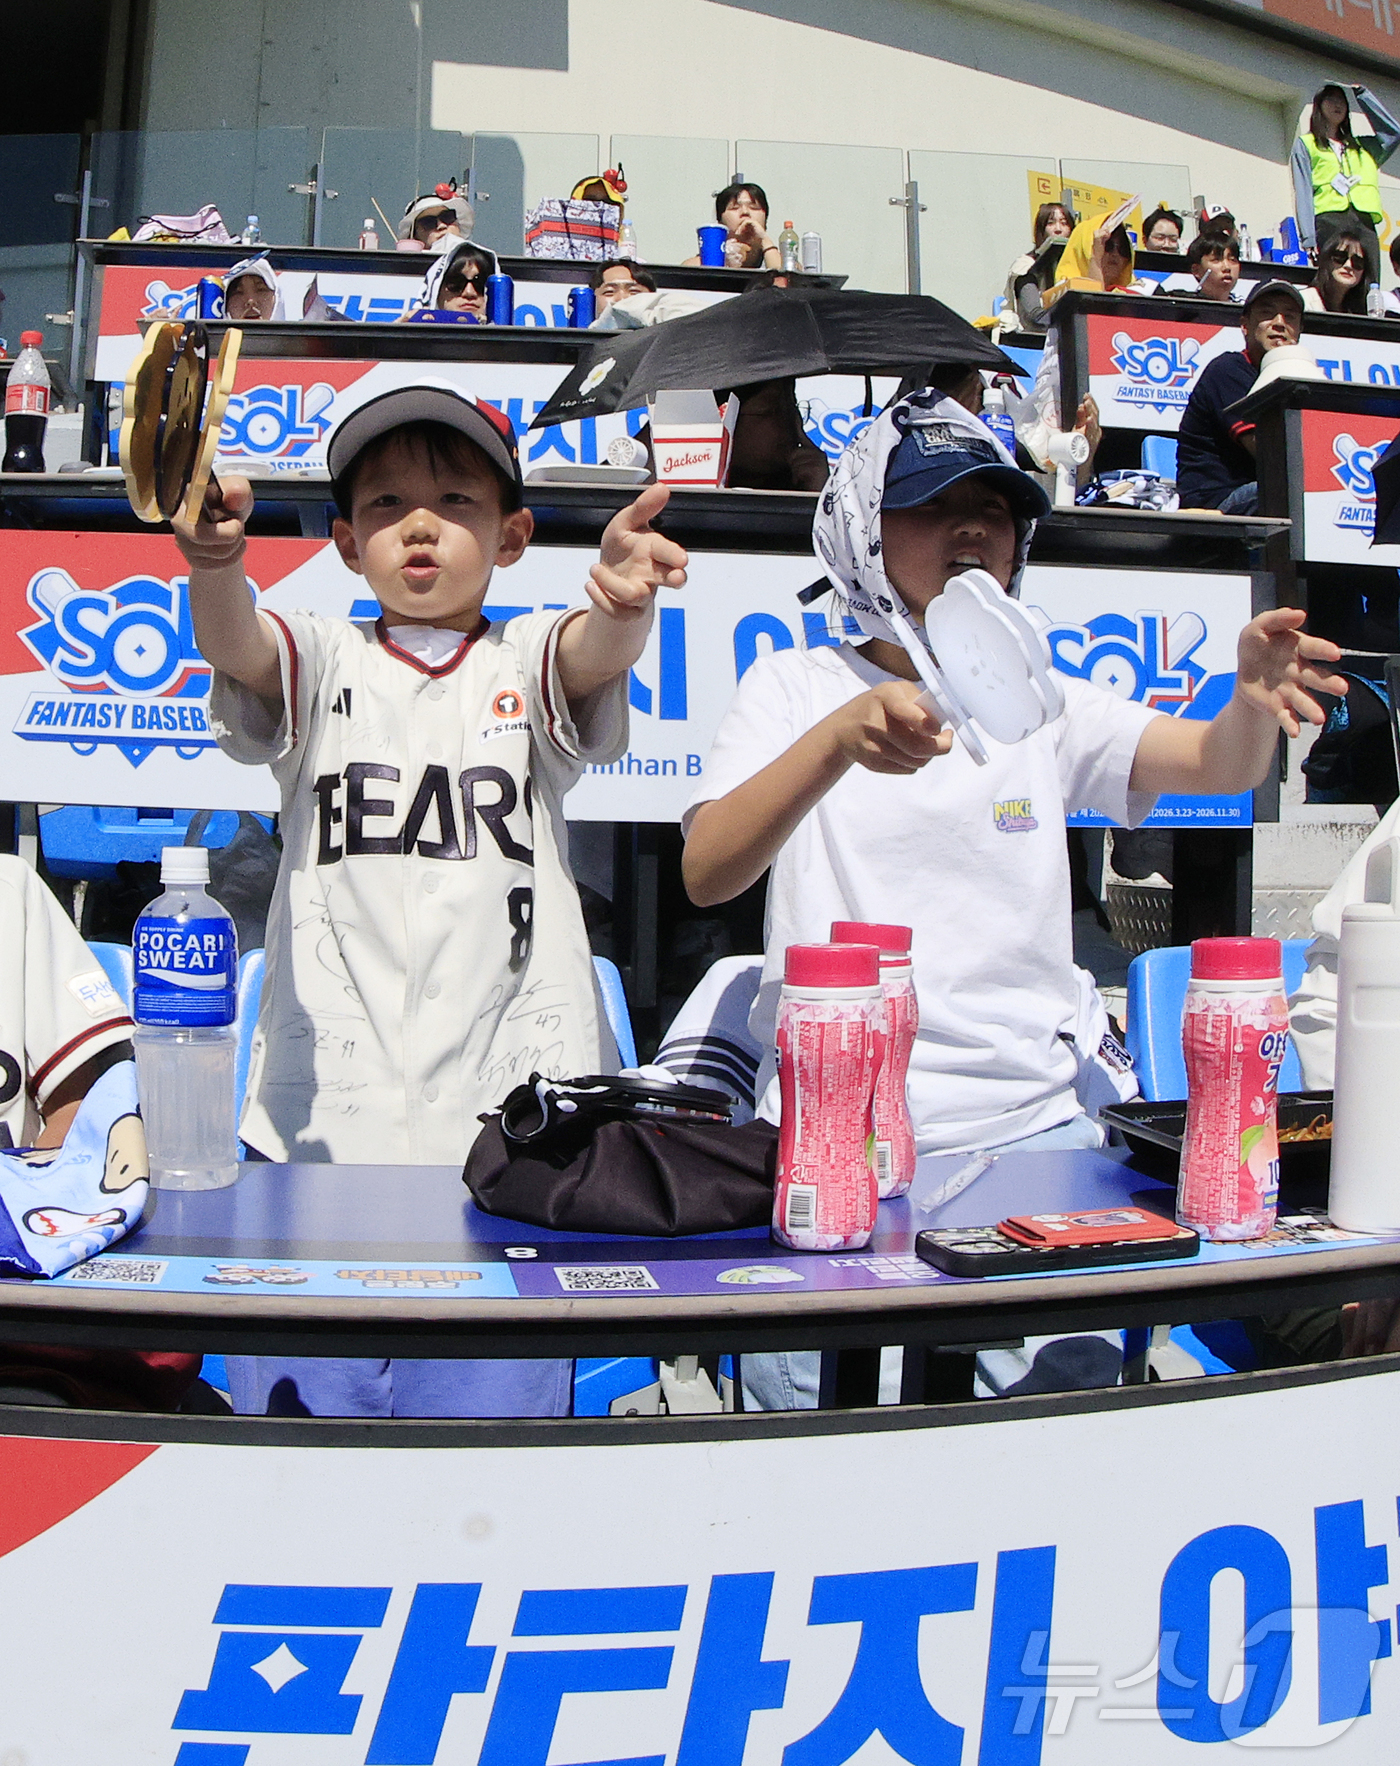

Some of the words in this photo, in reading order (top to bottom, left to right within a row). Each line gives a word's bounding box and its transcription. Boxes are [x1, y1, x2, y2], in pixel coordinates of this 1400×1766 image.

[1126, 340, 1190, 384] SOL
[1117, 386, 1155, 399] FANTASY
[1157, 389, 1191, 401] BASEBA
[216, 387, 317, 454] SOL
[663, 453, 712, 473] Jackson
[1339, 506, 1376, 522] FANTA
[57, 583, 209, 692] SOL
[1047, 616, 1183, 702] SOL
[25, 700, 127, 729] FANTASY
[131, 704, 210, 732] BASEB
[482, 721, 532, 739] T'Statio
[994, 799, 1031, 821] NIKE
[1147, 808, 1241, 819] (2026.3.23~2026.11.30)
[140, 933, 224, 951] POCARI
[138, 950, 218, 969] SWEAT
[171, 1545, 1057, 1766] 판타지
[1157, 1495, 1400, 1743] 야
